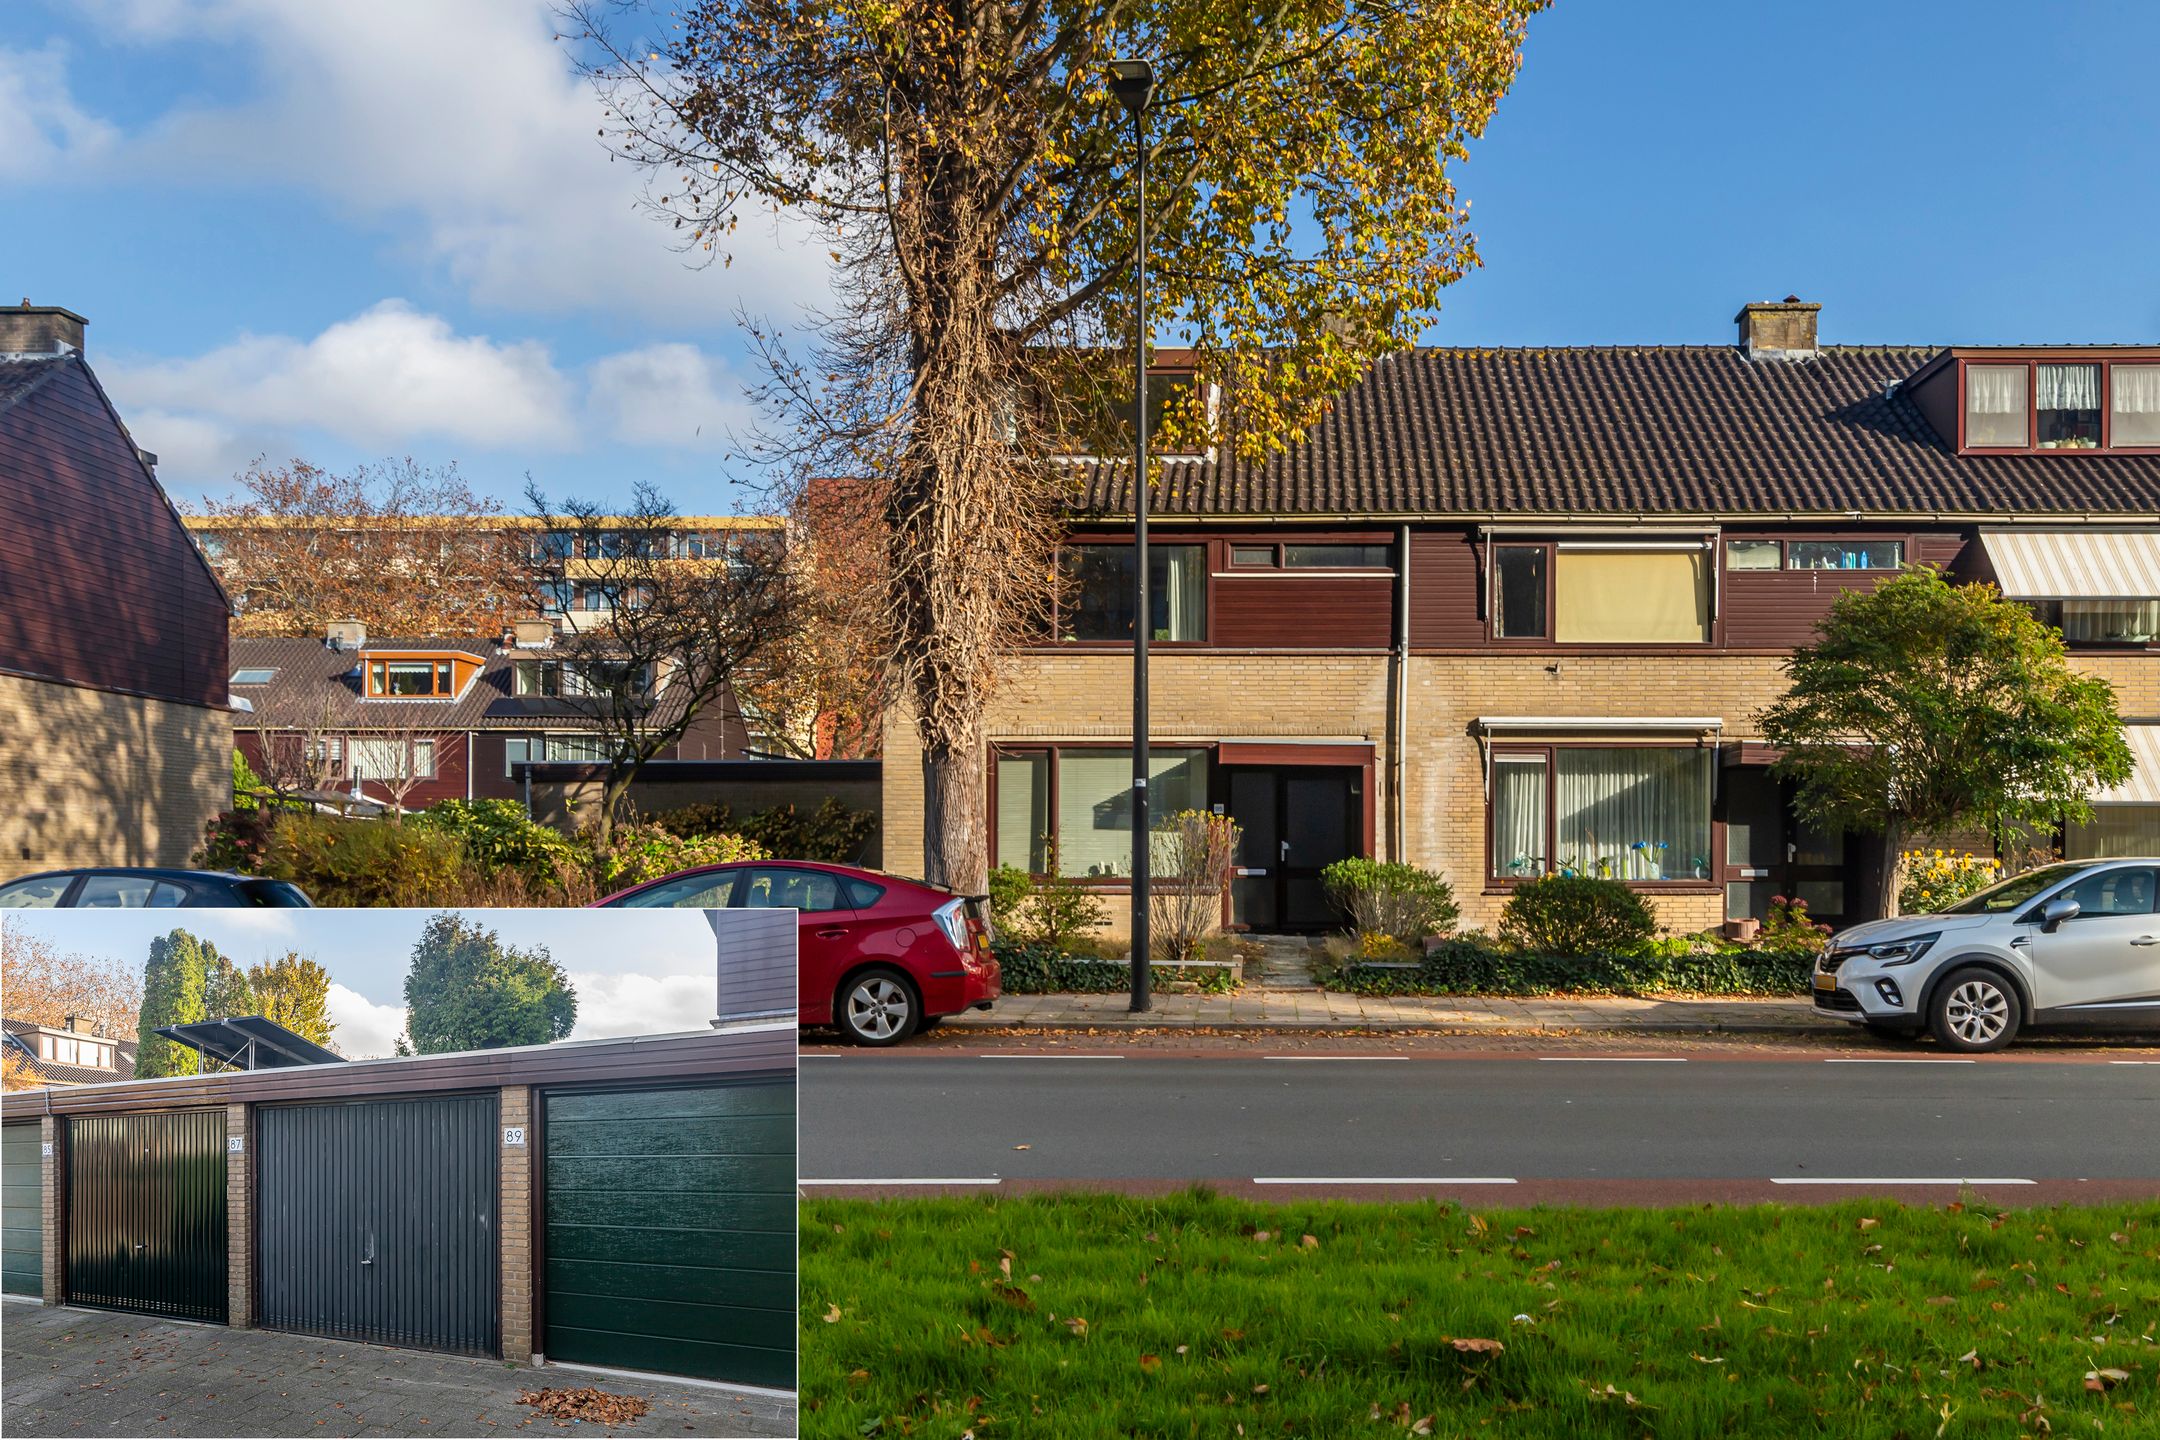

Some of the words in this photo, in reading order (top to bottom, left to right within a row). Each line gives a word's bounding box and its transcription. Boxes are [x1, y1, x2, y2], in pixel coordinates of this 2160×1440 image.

[506, 1130, 522, 1142] 89
[43, 1145, 52, 1153] 85
[230, 1139, 241, 1150] 87
